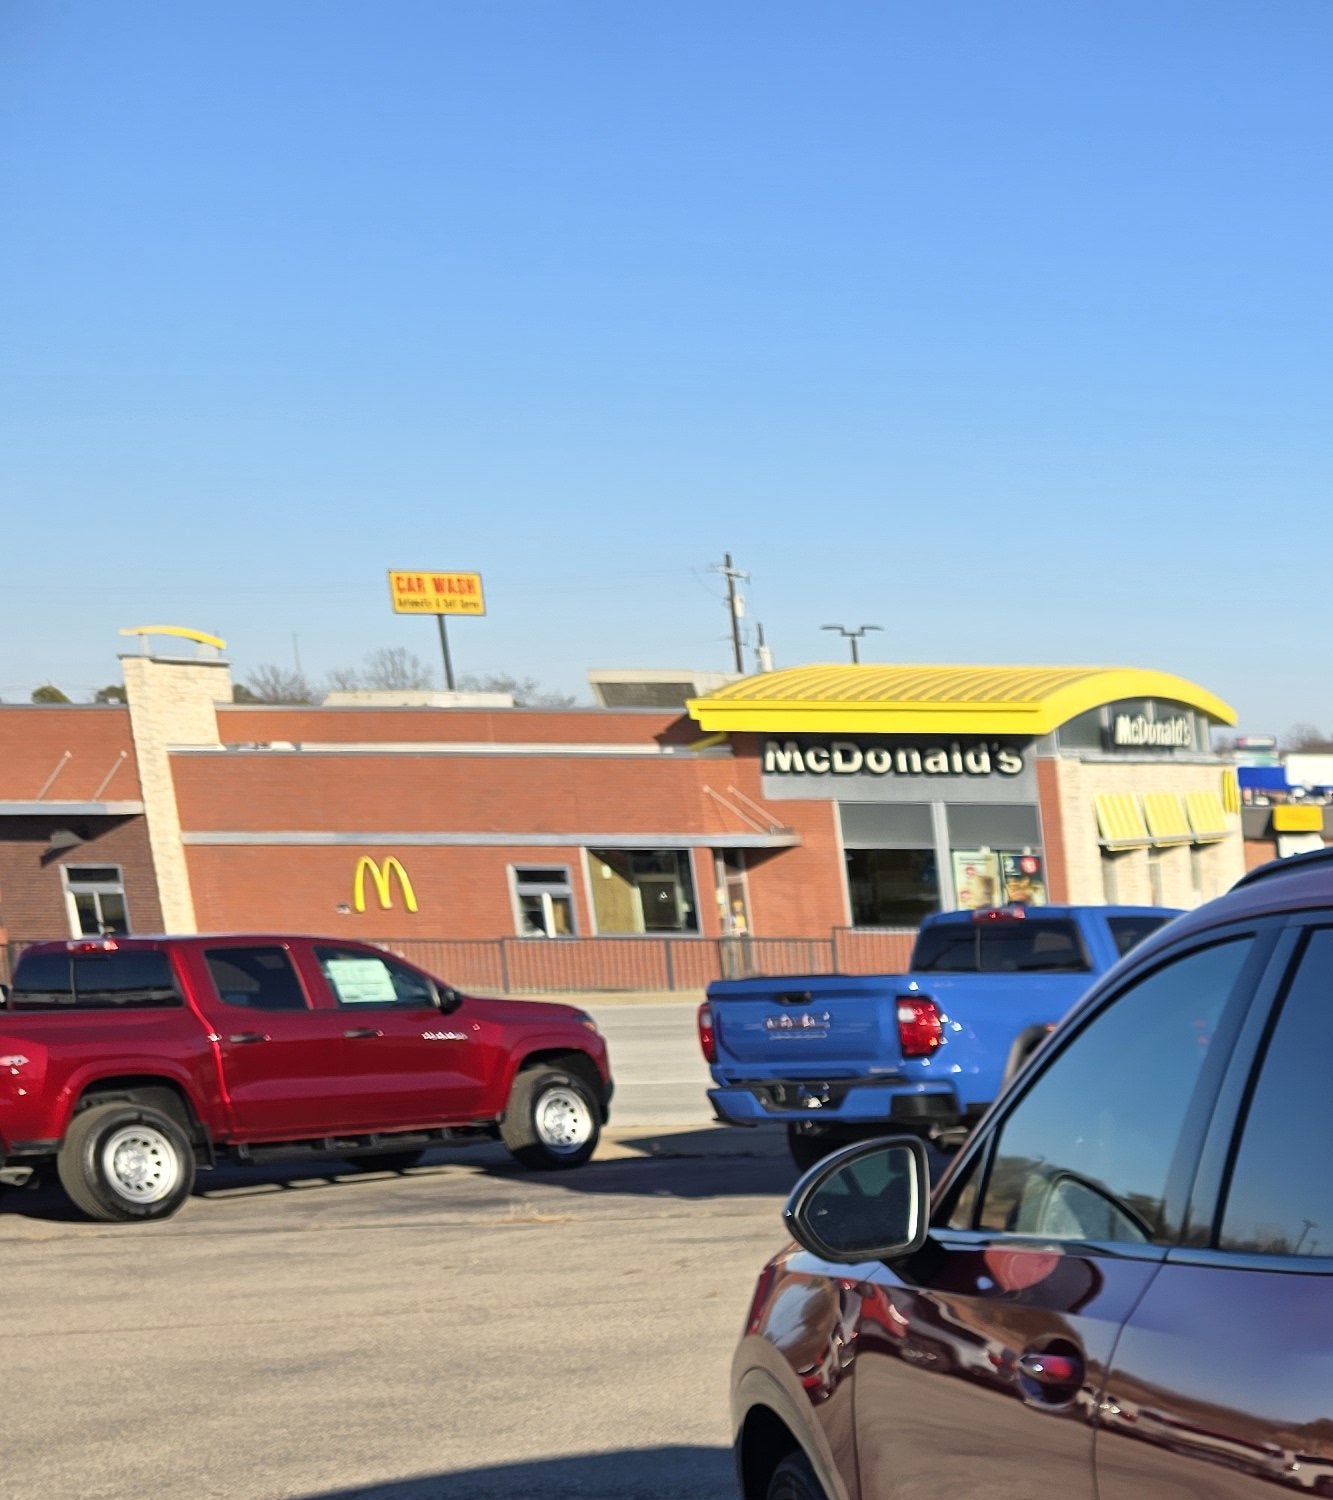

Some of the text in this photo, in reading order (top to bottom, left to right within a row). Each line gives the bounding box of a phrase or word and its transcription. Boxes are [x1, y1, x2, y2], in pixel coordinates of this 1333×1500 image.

[396, 576, 476, 595] CAR WASH
[1115, 715, 1191, 745] McDonald's
[765, 740, 1024, 774] McDonald's
